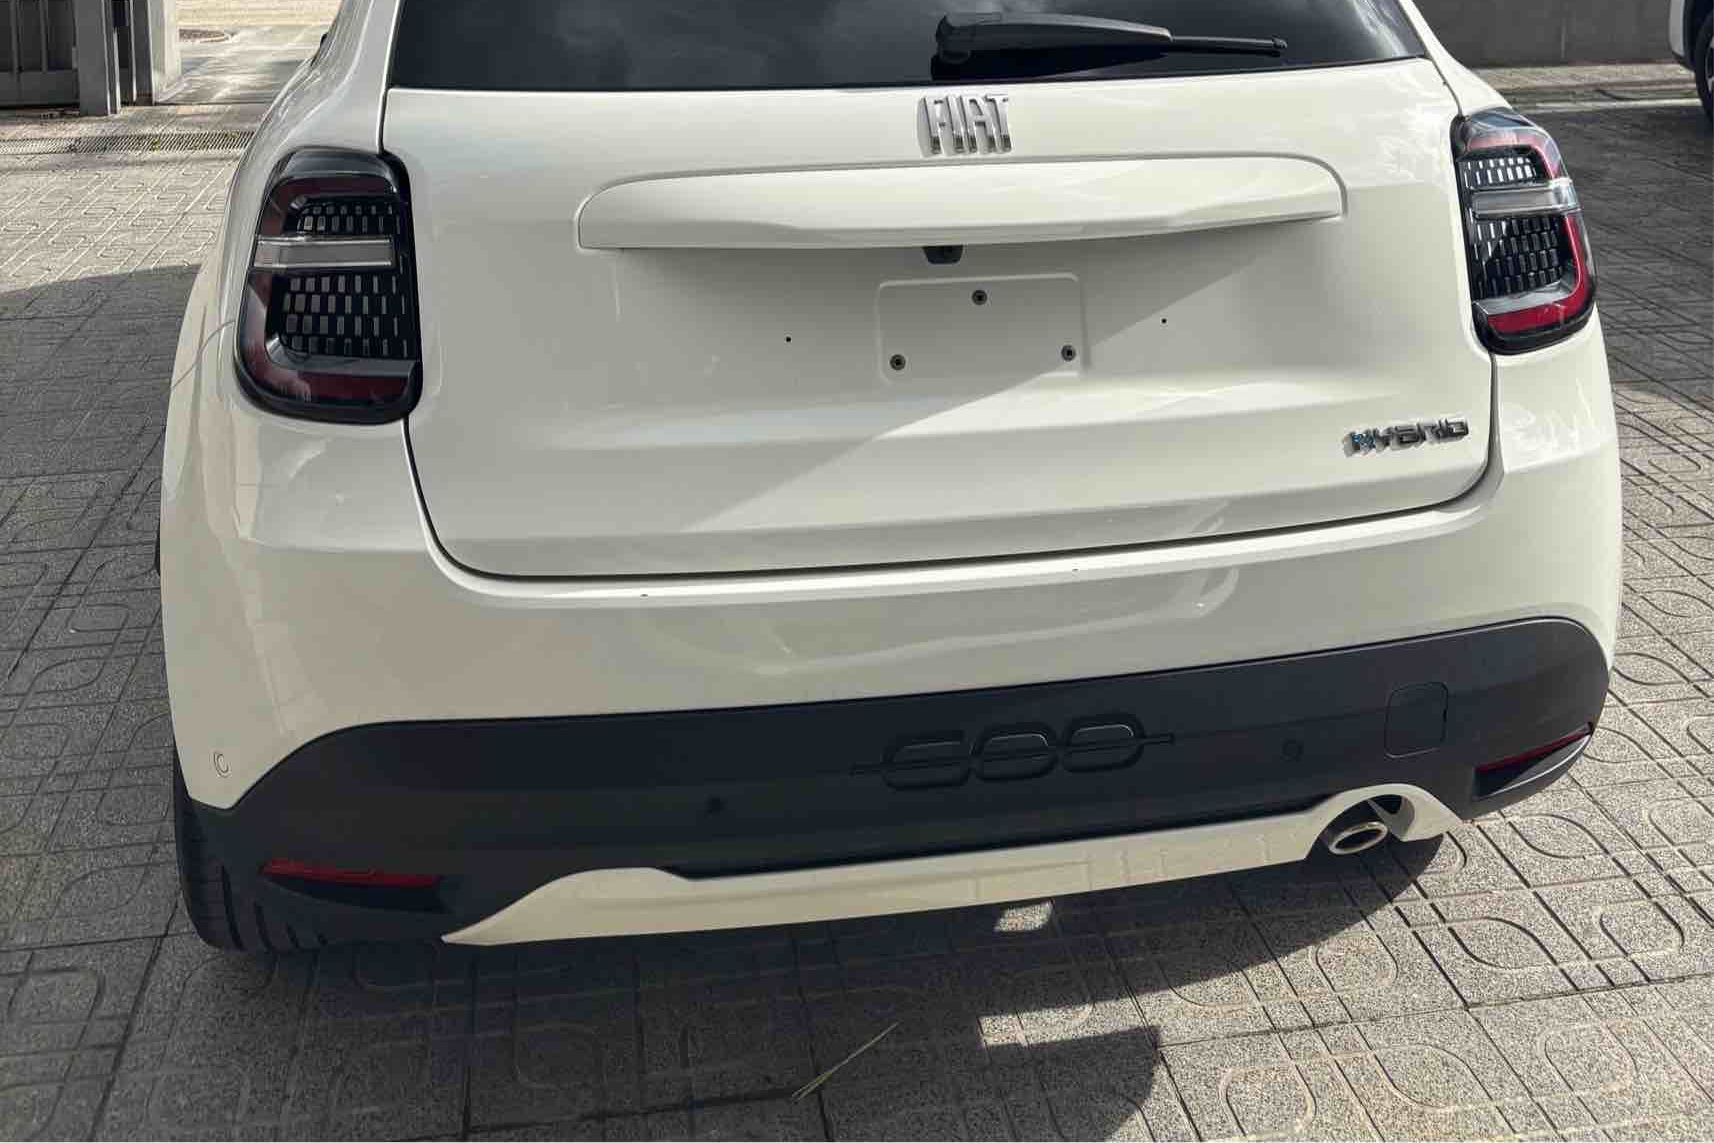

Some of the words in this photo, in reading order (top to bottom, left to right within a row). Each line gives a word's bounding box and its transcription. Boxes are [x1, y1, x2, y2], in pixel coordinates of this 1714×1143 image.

[917, 94, 1012, 157] FIAT
[1343, 418, 1469, 457] HYBRID
[878, 711, 1146, 794] 600
